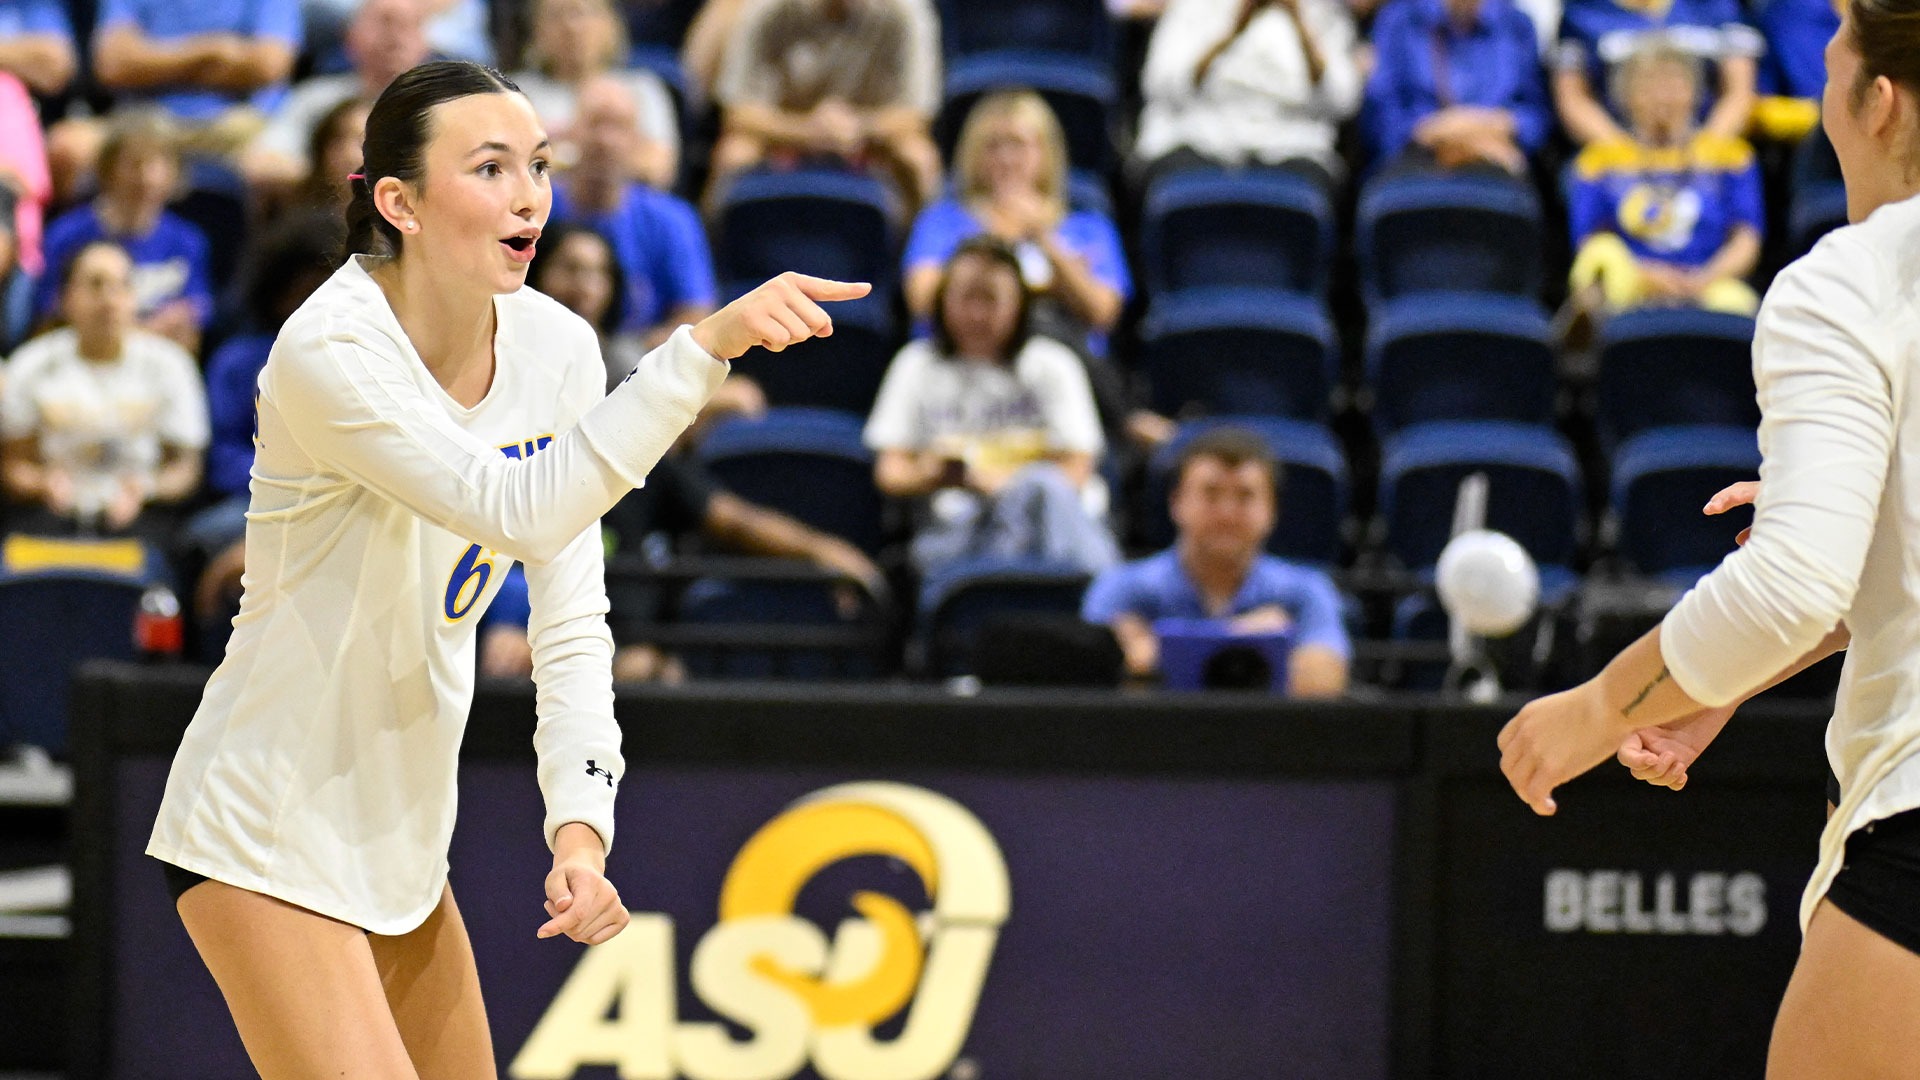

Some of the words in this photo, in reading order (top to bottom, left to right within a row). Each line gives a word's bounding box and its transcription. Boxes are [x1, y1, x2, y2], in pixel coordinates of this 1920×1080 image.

[443, 541, 495, 624] 6
[1544, 869, 1768, 936] BELLES
[508, 911, 1002, 1080] ASU
